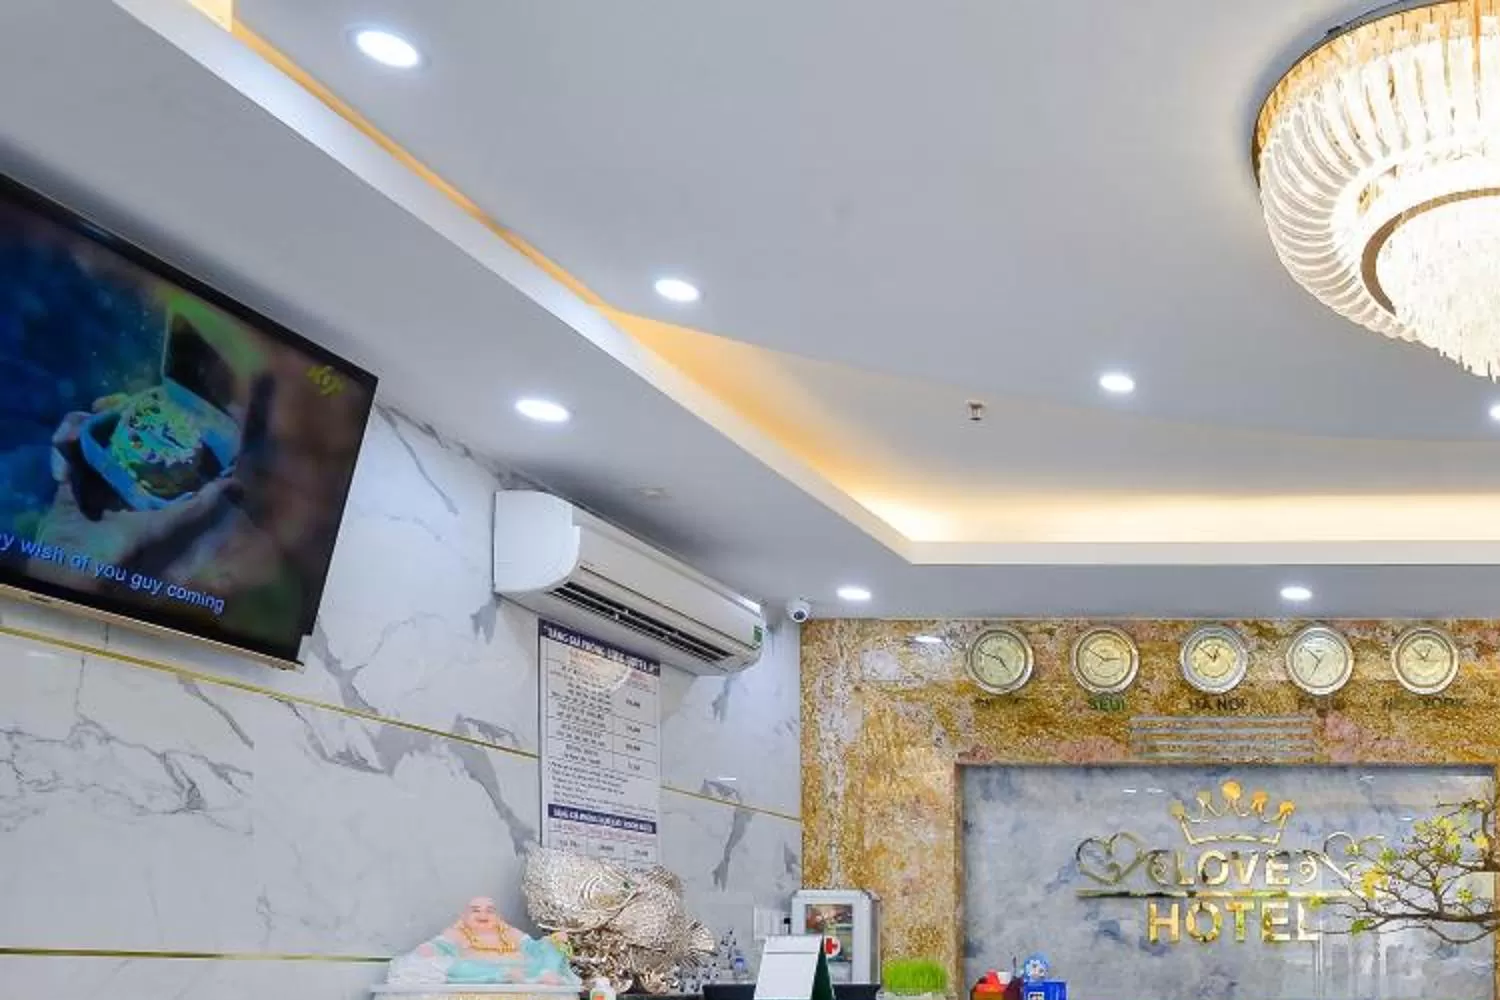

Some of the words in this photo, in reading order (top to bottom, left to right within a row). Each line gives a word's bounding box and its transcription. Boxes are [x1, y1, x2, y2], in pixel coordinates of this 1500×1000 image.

[69, 551, 90, 572] of
[94, 561, 127, 582] you
[130, 573, 163, 596] guy
[167, 583, 225, 614] coming
[1175, 850, 1292, 886] LOVE
[1147, 900, 1320, 944] HOTEL
